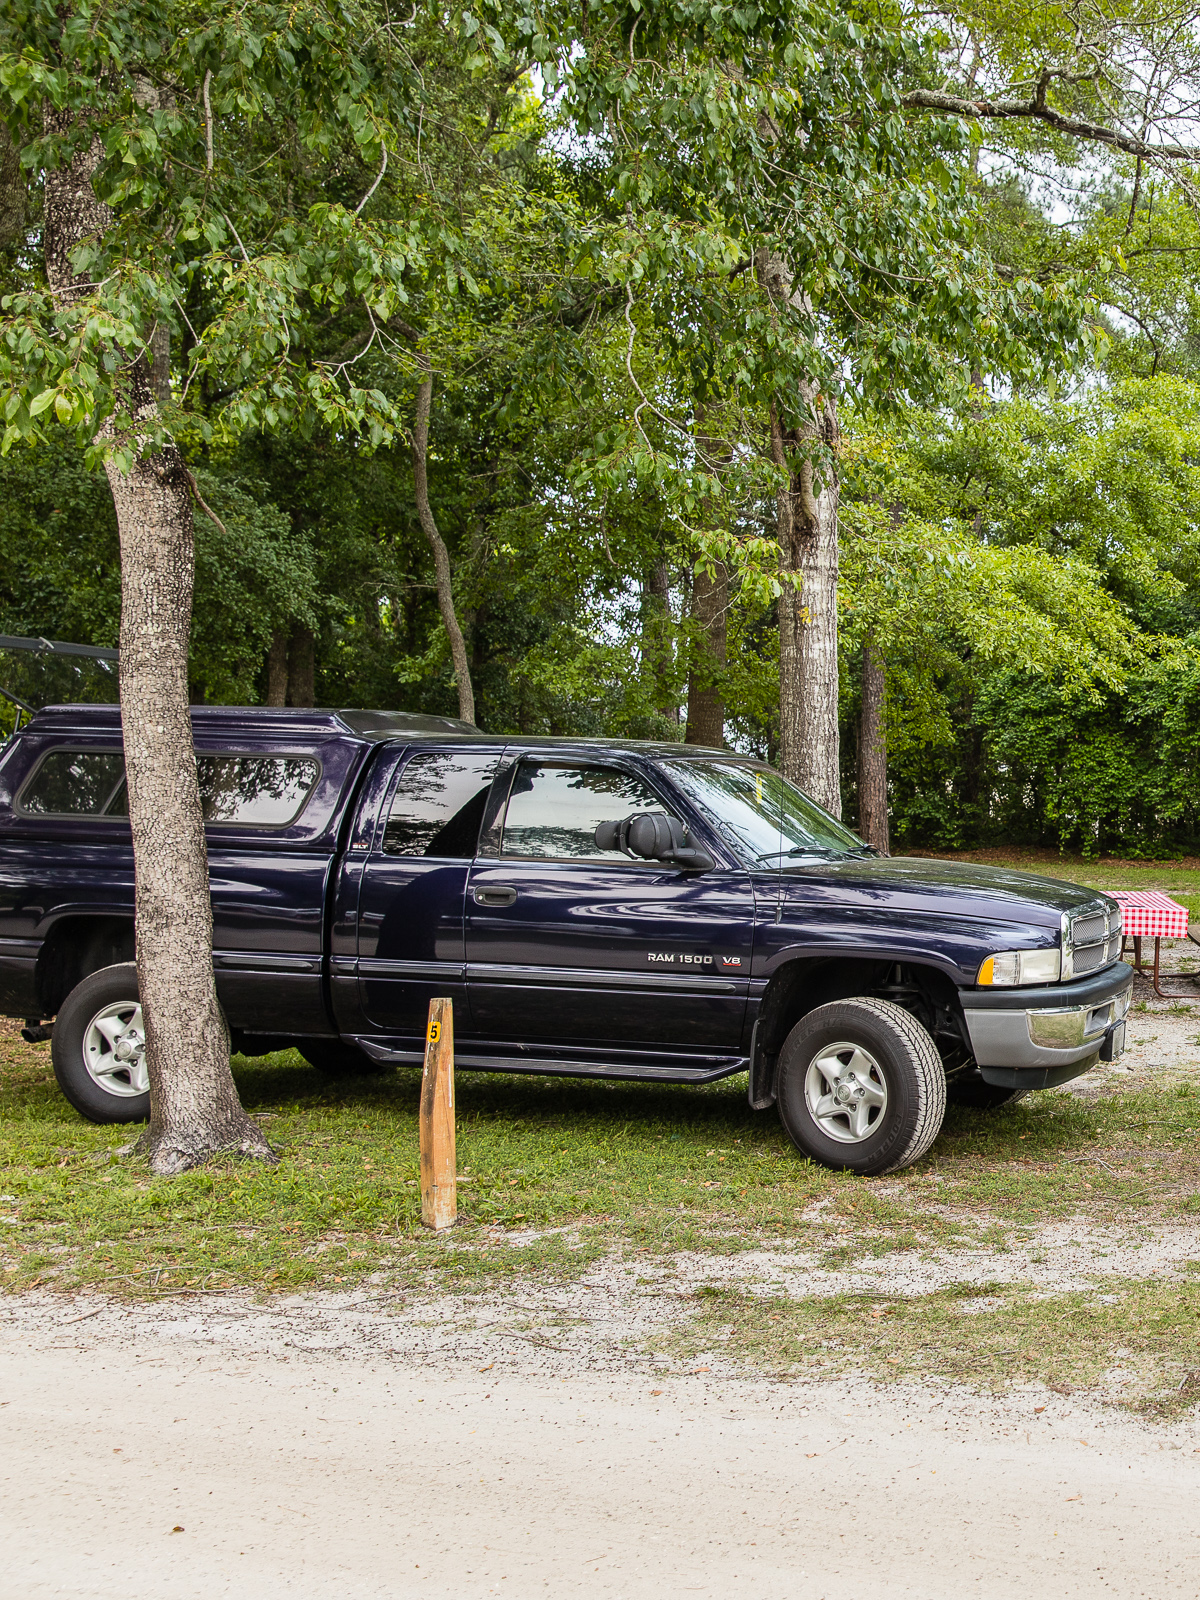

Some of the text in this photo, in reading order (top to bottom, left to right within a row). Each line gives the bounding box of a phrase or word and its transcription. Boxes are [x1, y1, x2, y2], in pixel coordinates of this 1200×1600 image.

[647, 953, 741, 965] RAM 1500 V8
[430, 1025, 438, 1039] 5
[866, 1113, 903, 1163] COOPER
